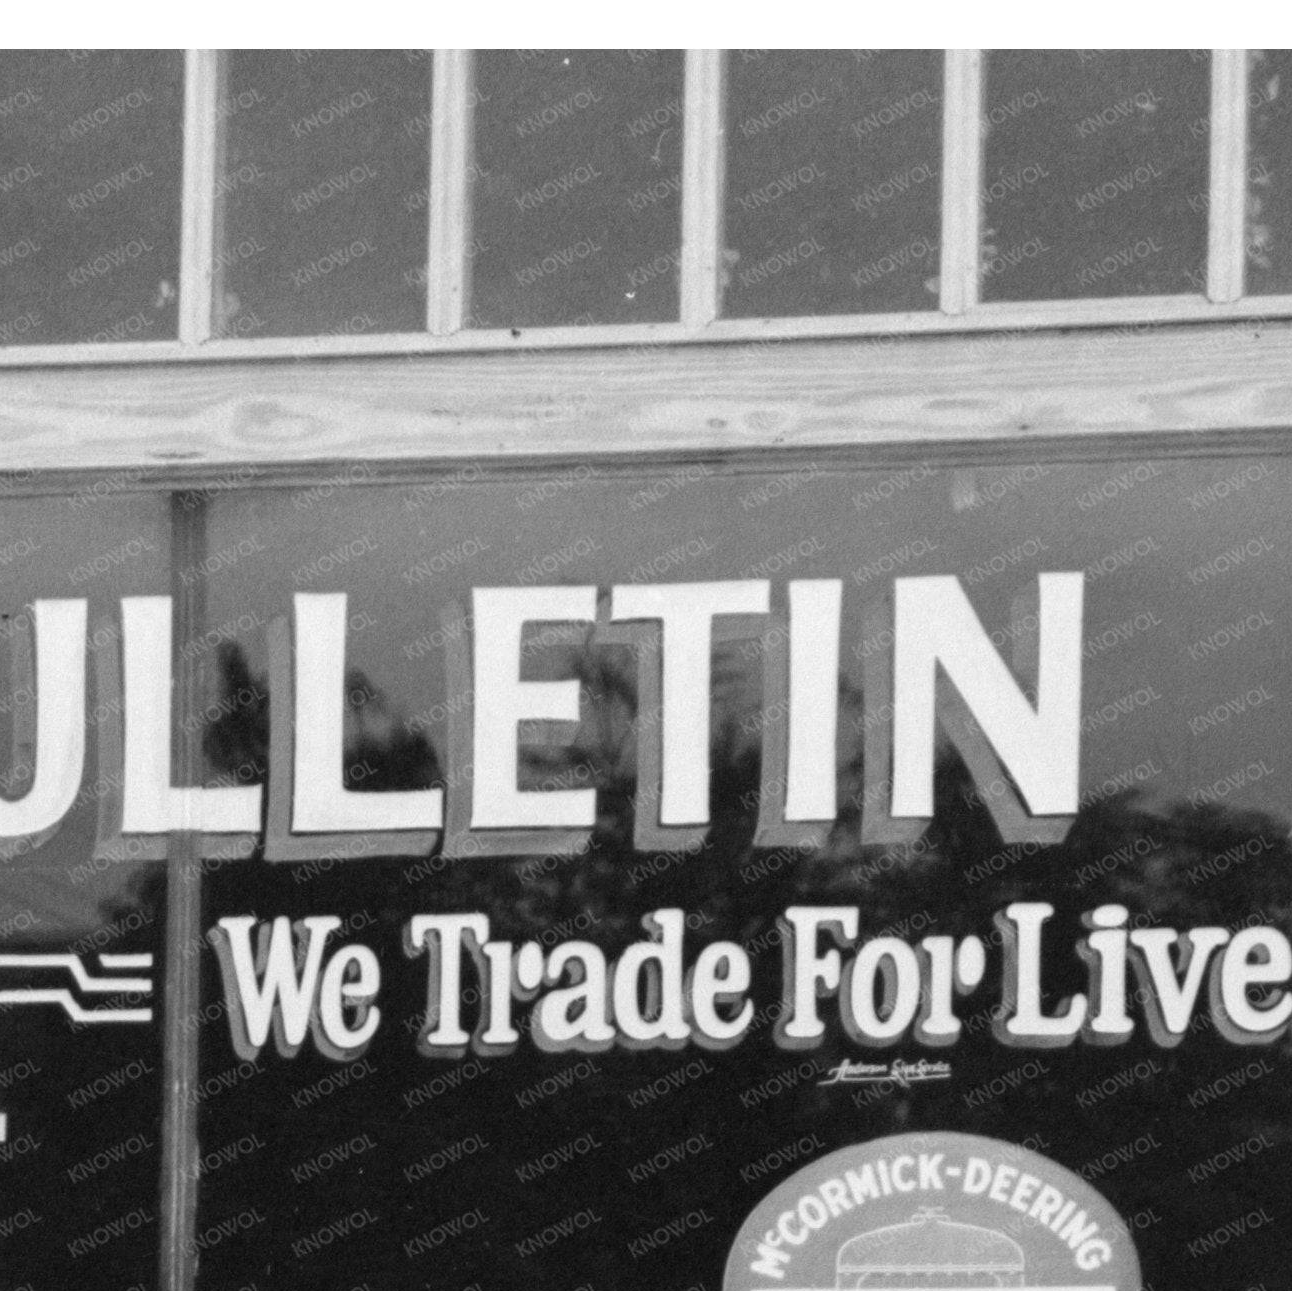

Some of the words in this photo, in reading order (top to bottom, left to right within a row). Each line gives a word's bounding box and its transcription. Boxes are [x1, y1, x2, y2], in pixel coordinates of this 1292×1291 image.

[217, 914, 381, 1048] We
[411, 906, 755, 1045] Trade
[783, 905, 987, 1039] For
